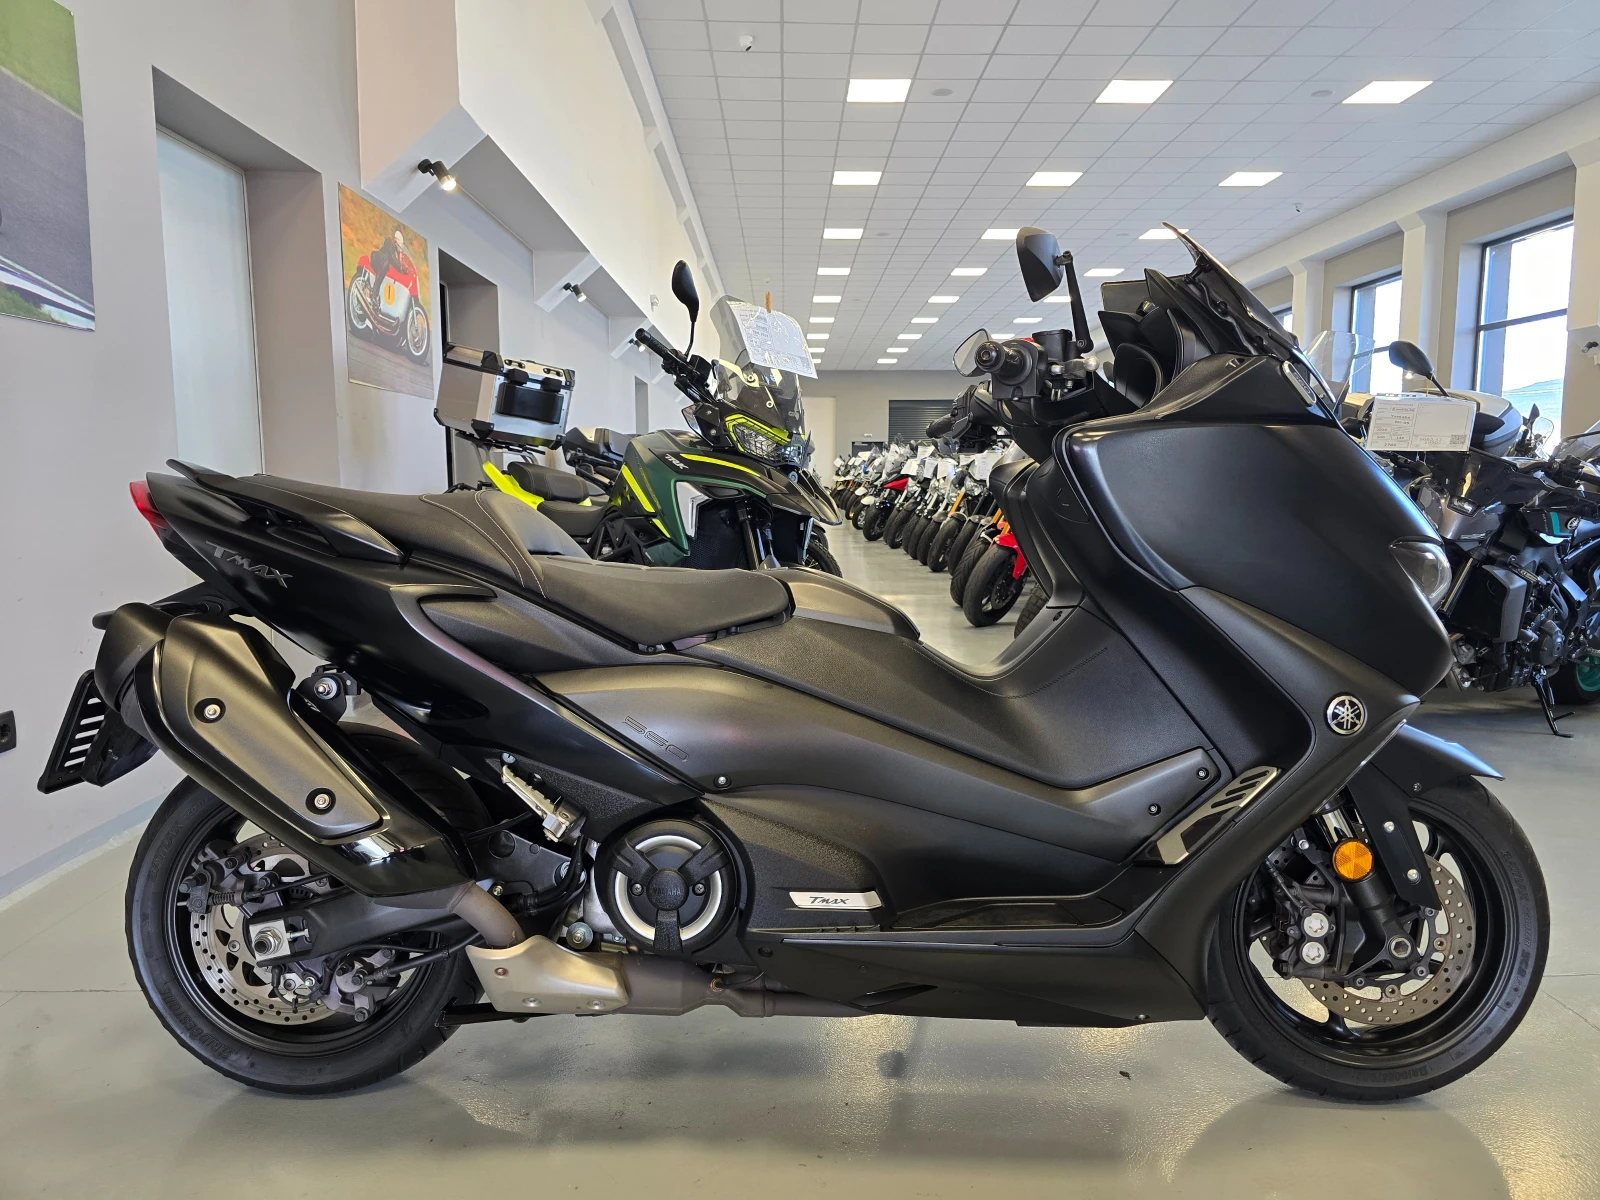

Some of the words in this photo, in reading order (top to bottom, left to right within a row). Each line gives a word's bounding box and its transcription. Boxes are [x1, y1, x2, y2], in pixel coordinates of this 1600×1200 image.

[664, 453, 690, 470] TRK
[205, 540, 294, 589] TMAX
[622, 715, 690, 762] 560
[148, 819, 184, 884] BATTLAX
[652, 886, 682, 896] YAMAHA
[809, 896, 850, 905] TMAX
[158, 986, 236, 1060] BRIDGESTONE
